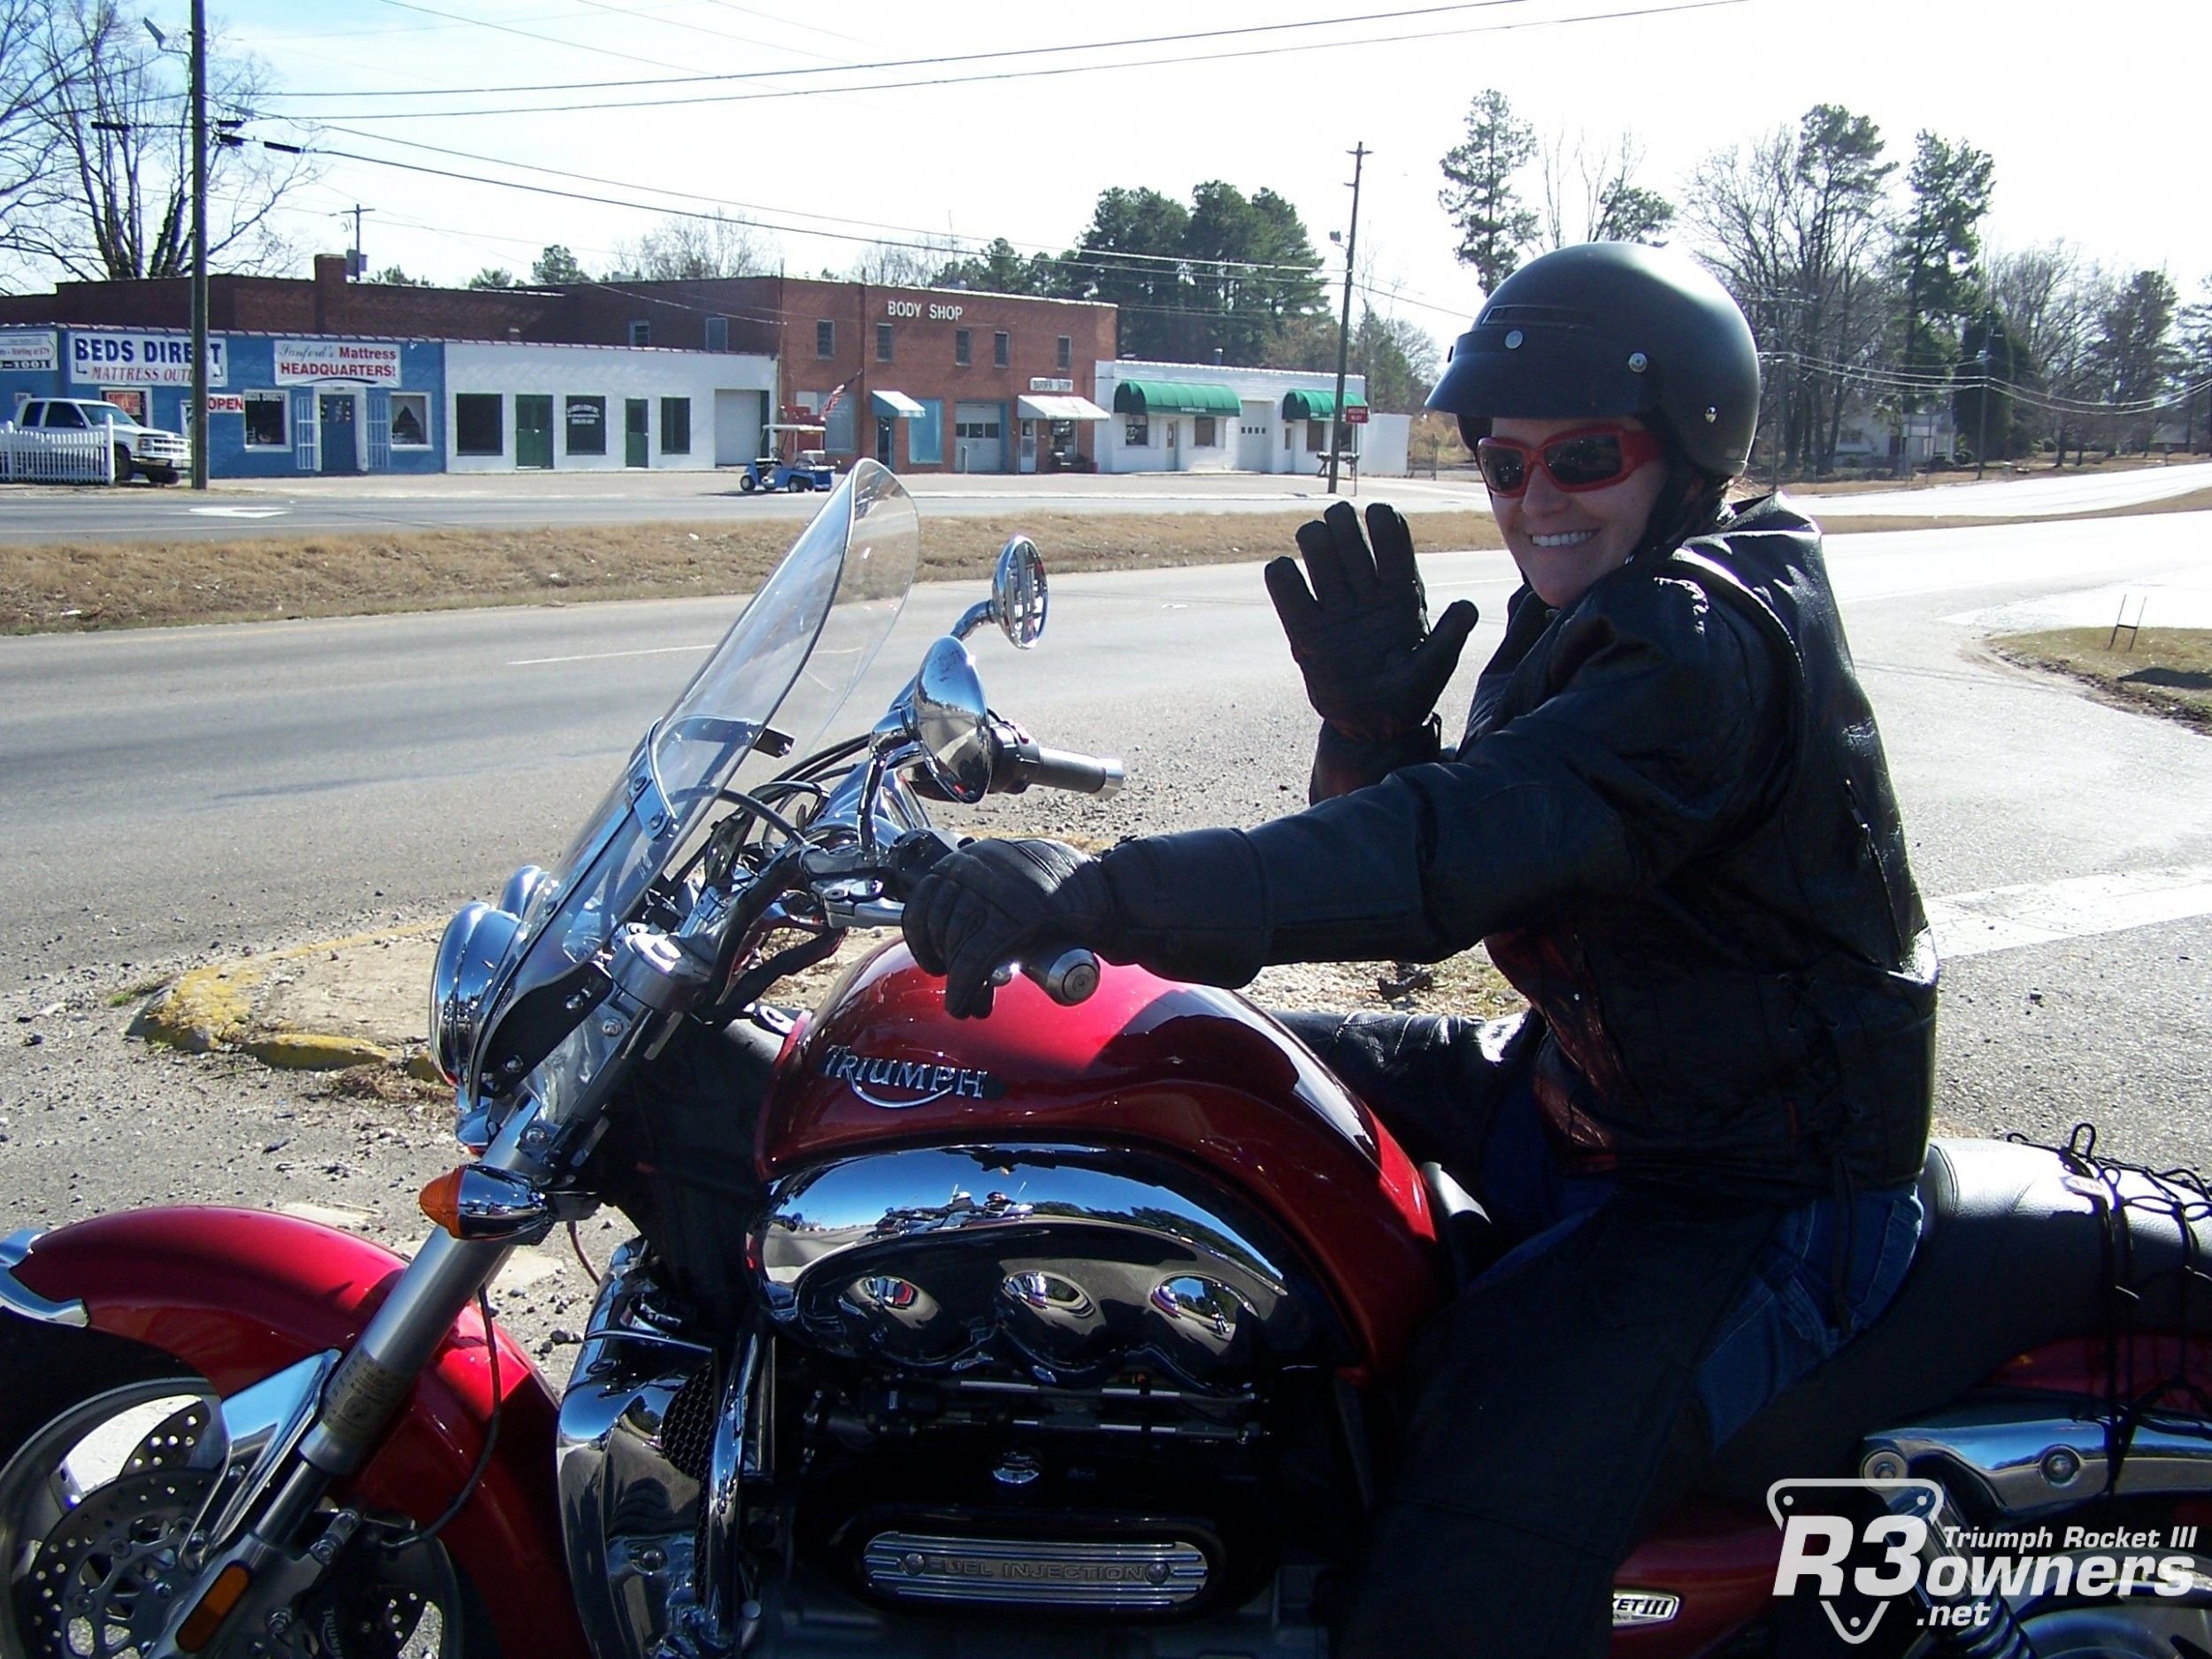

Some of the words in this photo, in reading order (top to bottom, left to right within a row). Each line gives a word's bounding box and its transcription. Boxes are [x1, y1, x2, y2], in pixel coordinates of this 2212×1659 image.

[887, 301, 921, 318] BODY
[929, 303, 963, 320] SHOP
[74, 338, 134, 362] BEDS
[143, 341, 221, 364] DIRET
[339, 346, 396, 360] Mattress
[92, 366, 159, 381] MATTRESS
[280, 362, 396, 377] HEADQUARTERS!
[208, 397, 243, 411] OPEN
[825, 1044, 987, 1099] TRIUMPH
[1003, 1561, 1146, 1581] INJECTION
